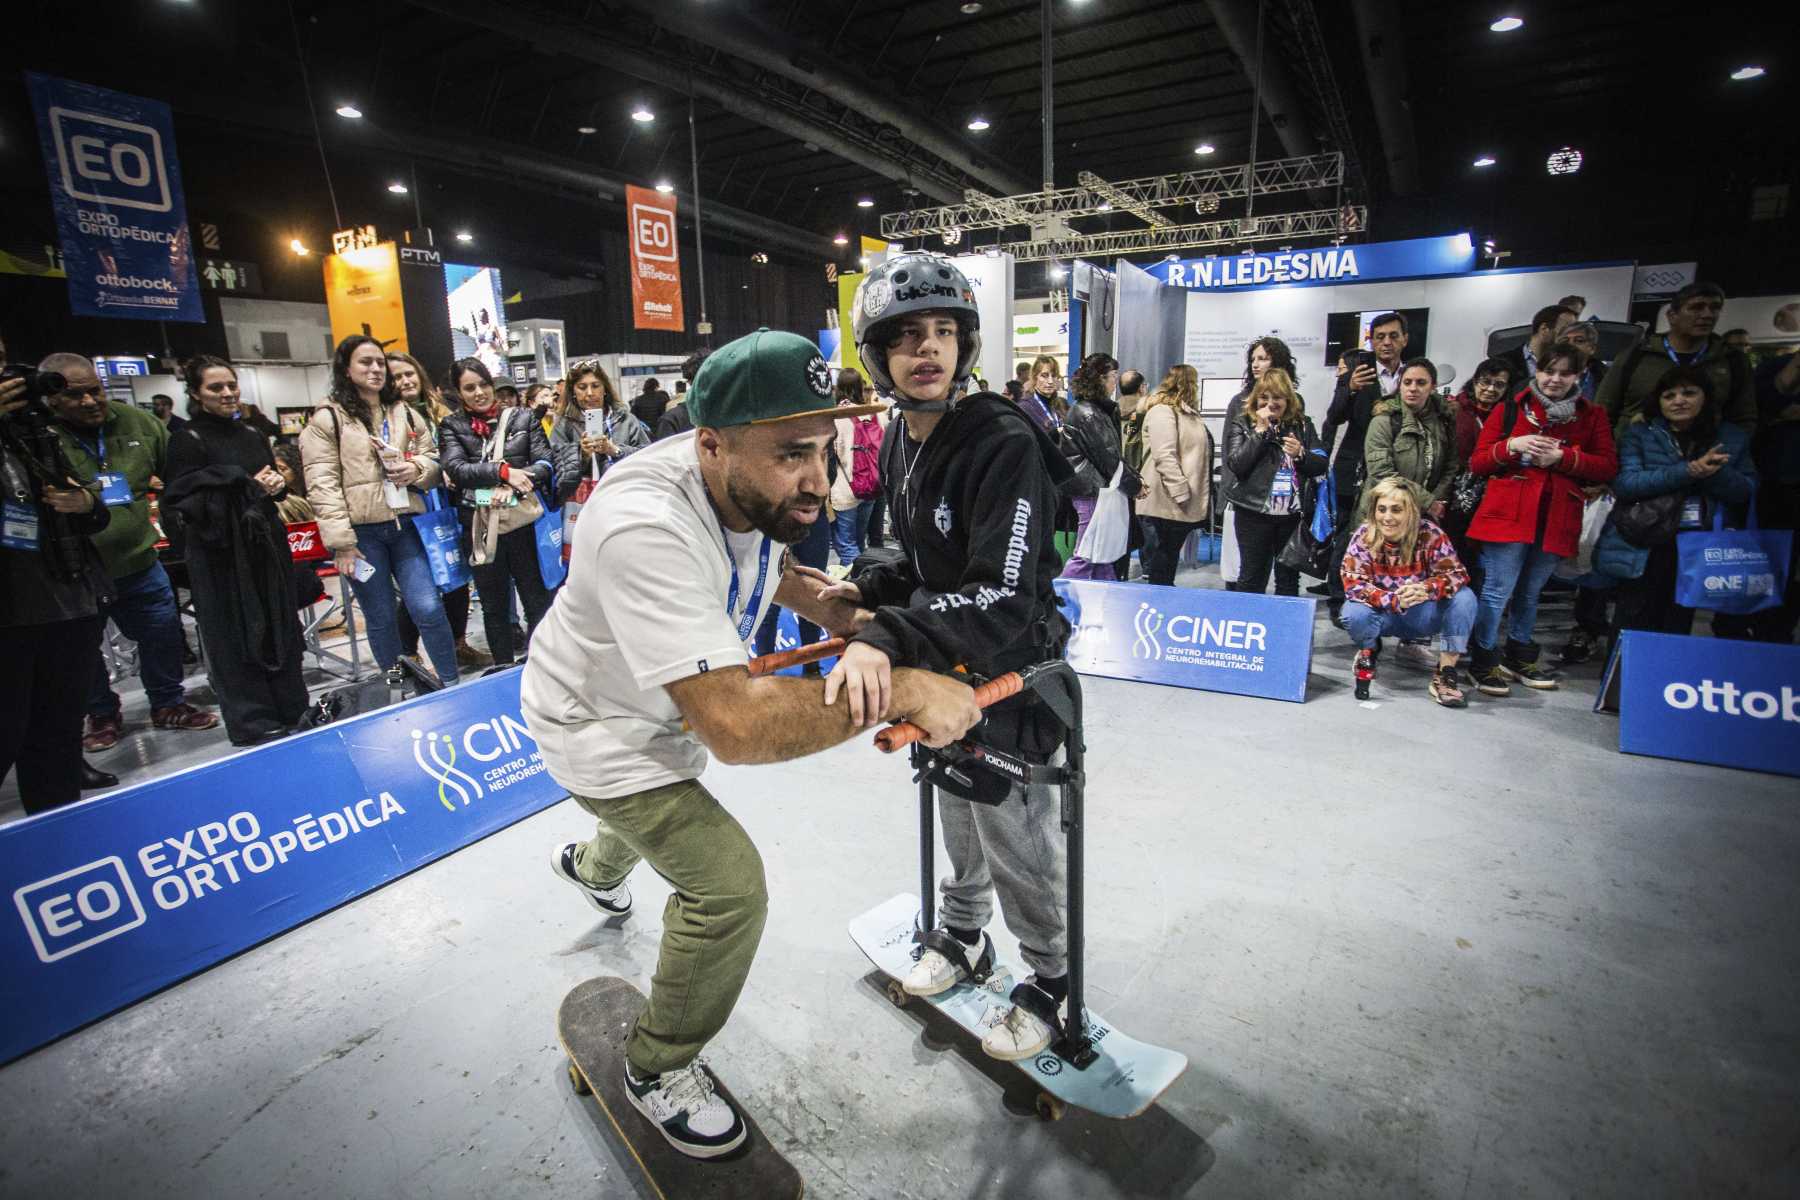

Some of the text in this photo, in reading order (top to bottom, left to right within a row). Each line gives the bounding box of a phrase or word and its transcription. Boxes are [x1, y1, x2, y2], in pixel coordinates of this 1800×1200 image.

[71, 135, 151, 187] EO
[78, 209, 119, 227] EXPO
[639, 219, 669, 248] EO
[400, 248, 441, 263] PTM
[1003, 498, 1031, 587] company
[1166, 615, 1267, 650] CINER
[1166, 646, 1265, 665] CENTRO INTEGRAL DE
[483, 757, 527, 782] CENTRO
[984, 752, 1024, 777] YOKOHAMA
[137, 811, 262, 878] EXPO
[38, 880, 122, 938] EO
